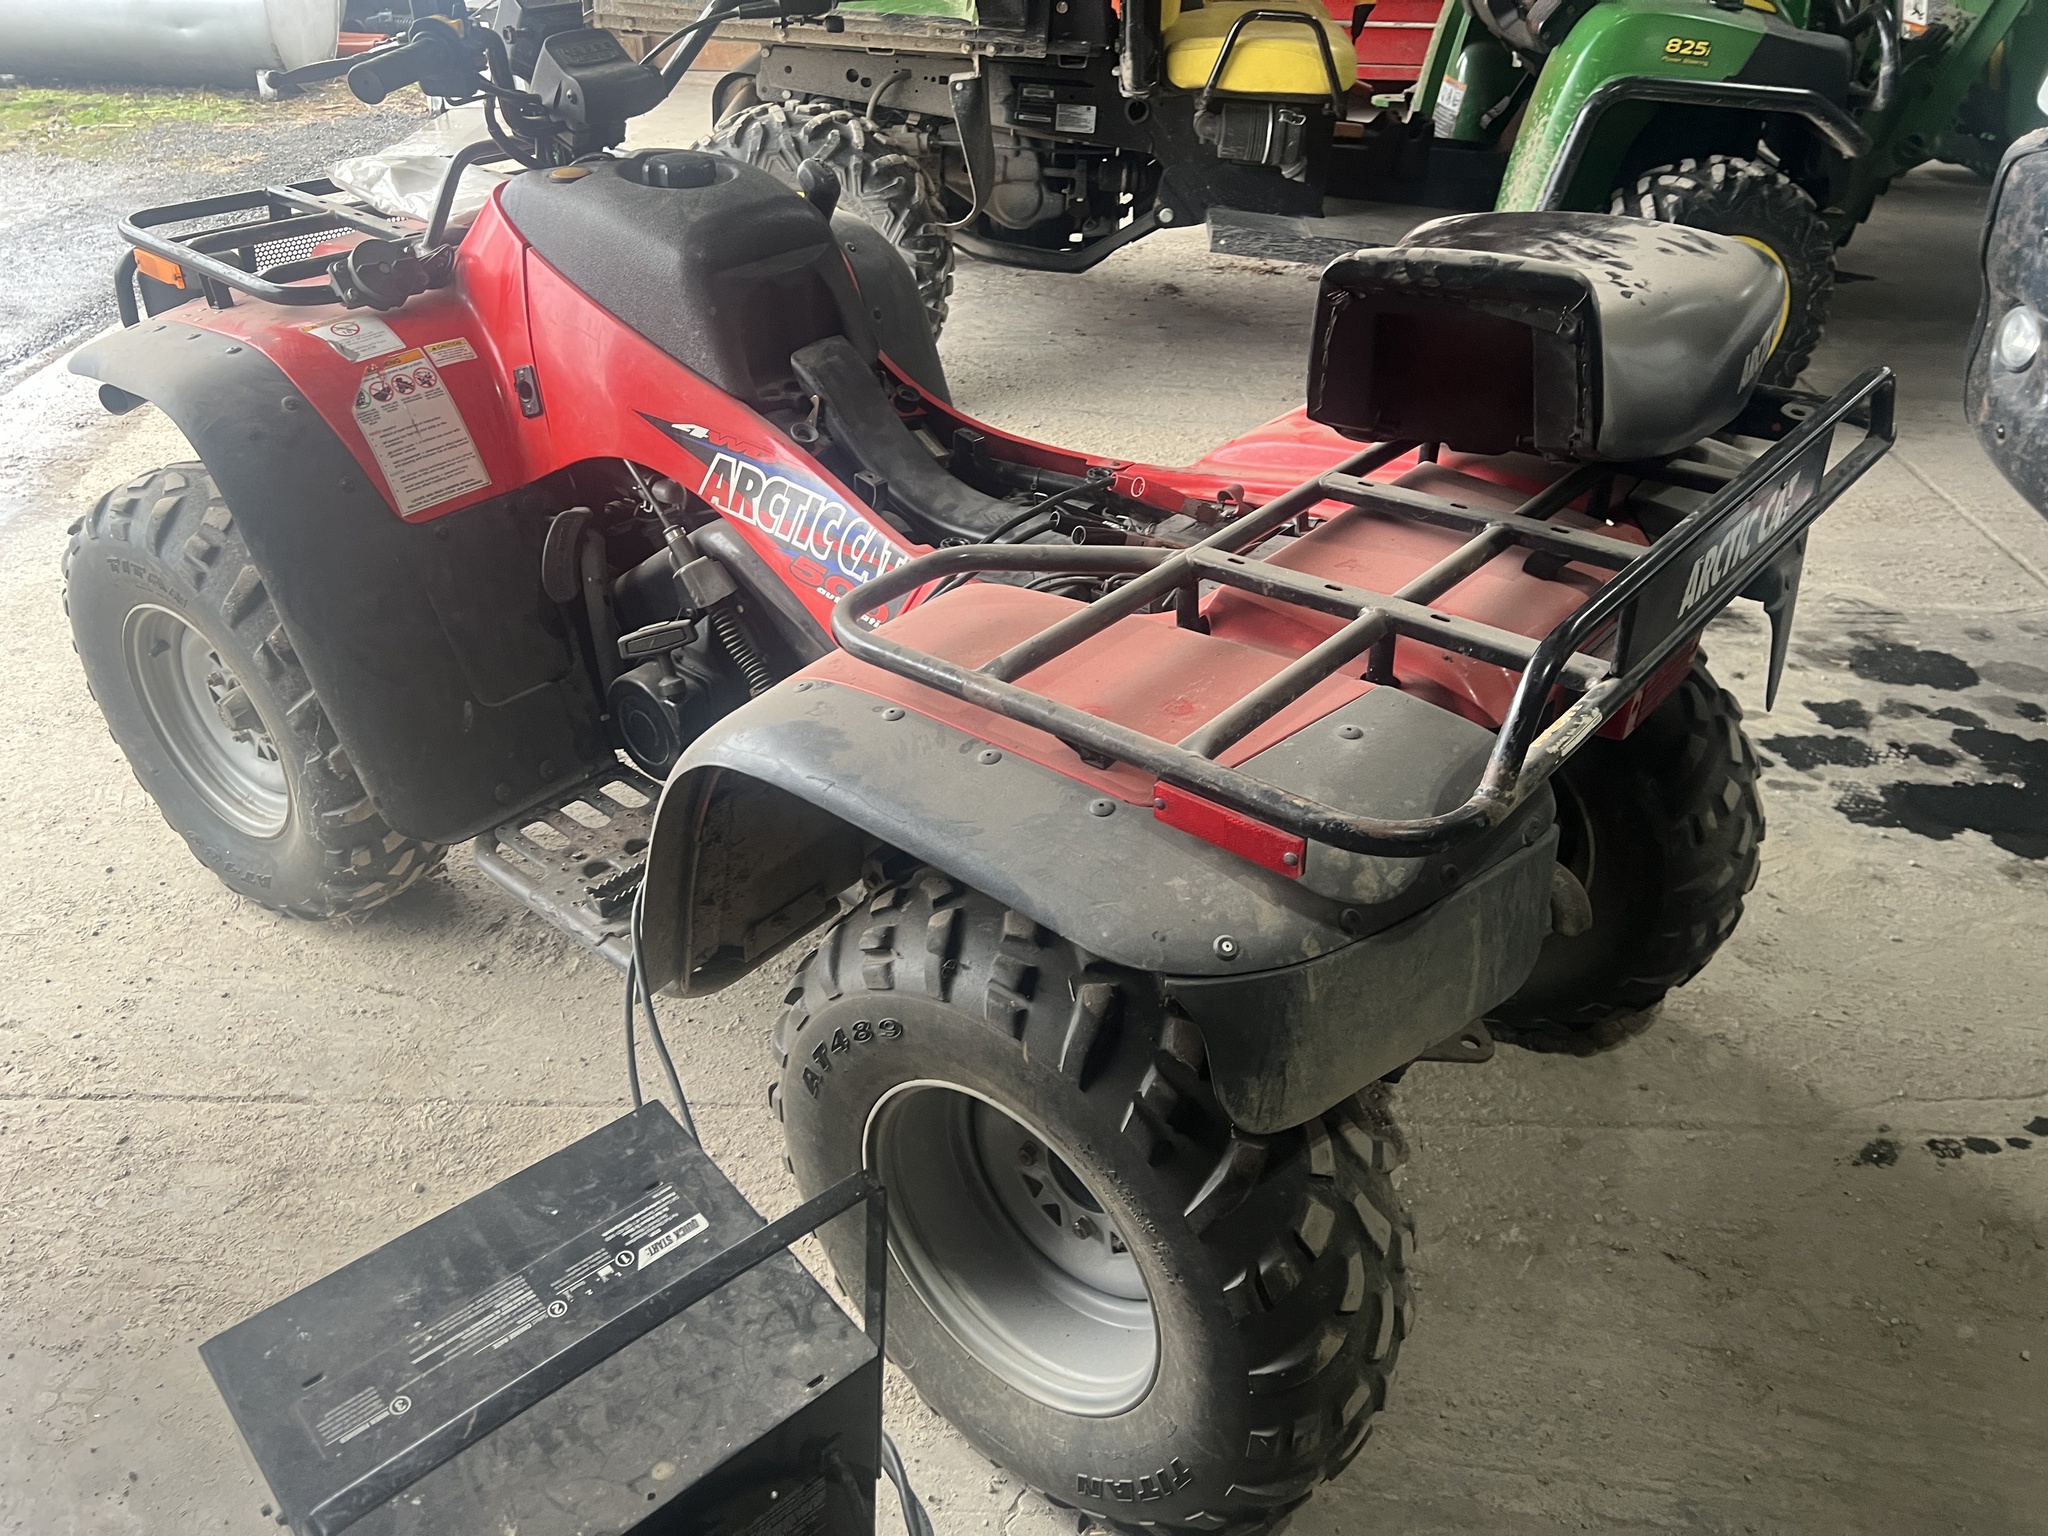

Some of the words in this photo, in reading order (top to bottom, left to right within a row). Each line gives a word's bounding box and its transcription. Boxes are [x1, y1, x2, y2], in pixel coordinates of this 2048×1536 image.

[671, 423, 780, 464] 4WD
[698, 452, 847, 561] ARCTIC
[1677, 504, 1762, 619] ARCTIC
[801, 1017, 904, 1099] AT489
[671, 1218, 701, 1239] QUICK
[1077, 1456, 1193, 1502] TITAN
